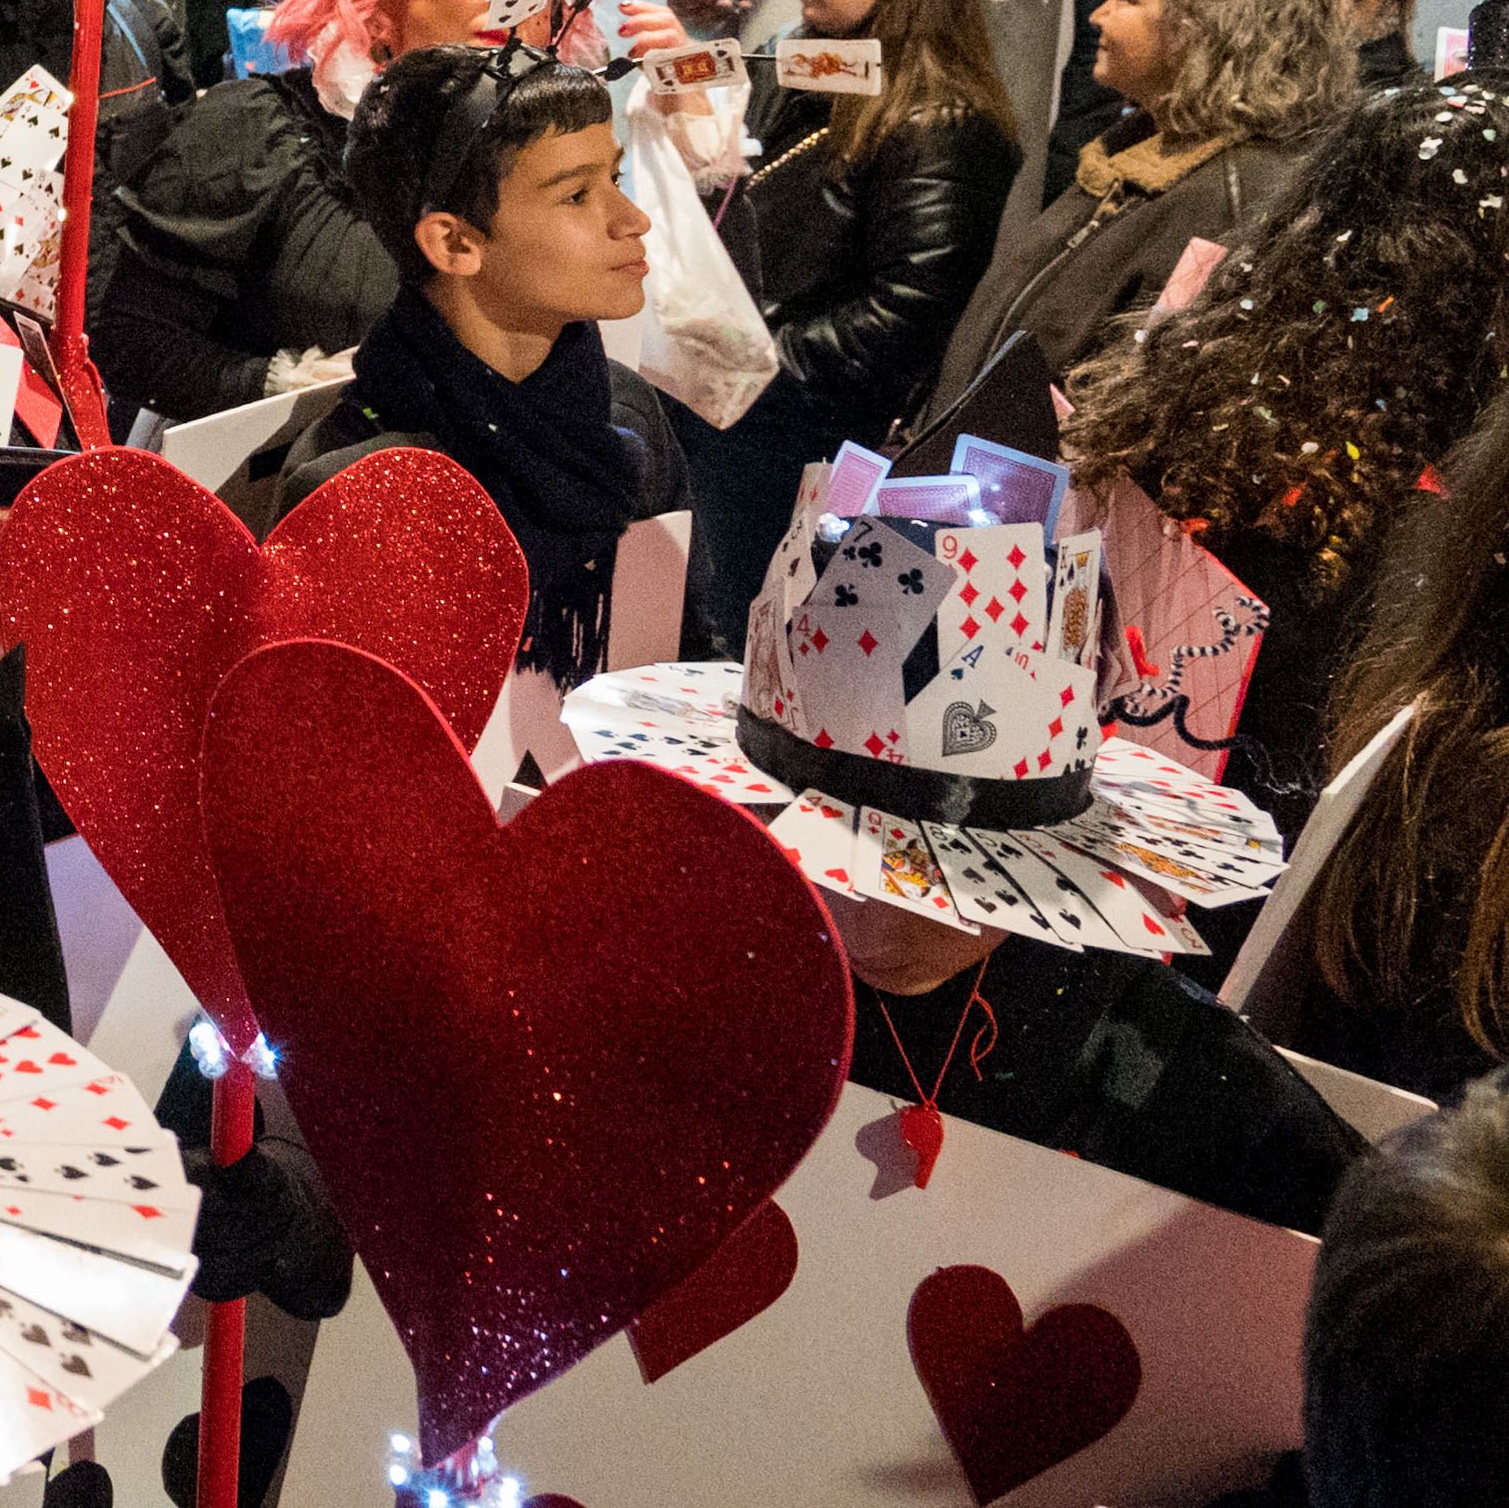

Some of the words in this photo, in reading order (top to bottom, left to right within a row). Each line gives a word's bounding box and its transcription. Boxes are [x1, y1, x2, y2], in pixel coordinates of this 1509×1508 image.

[854, 521, 873, 542] 7
[942, 535, 958, 560] 9
[796, 613, 811, 634] 4
[961, 644, 985, 669] A
